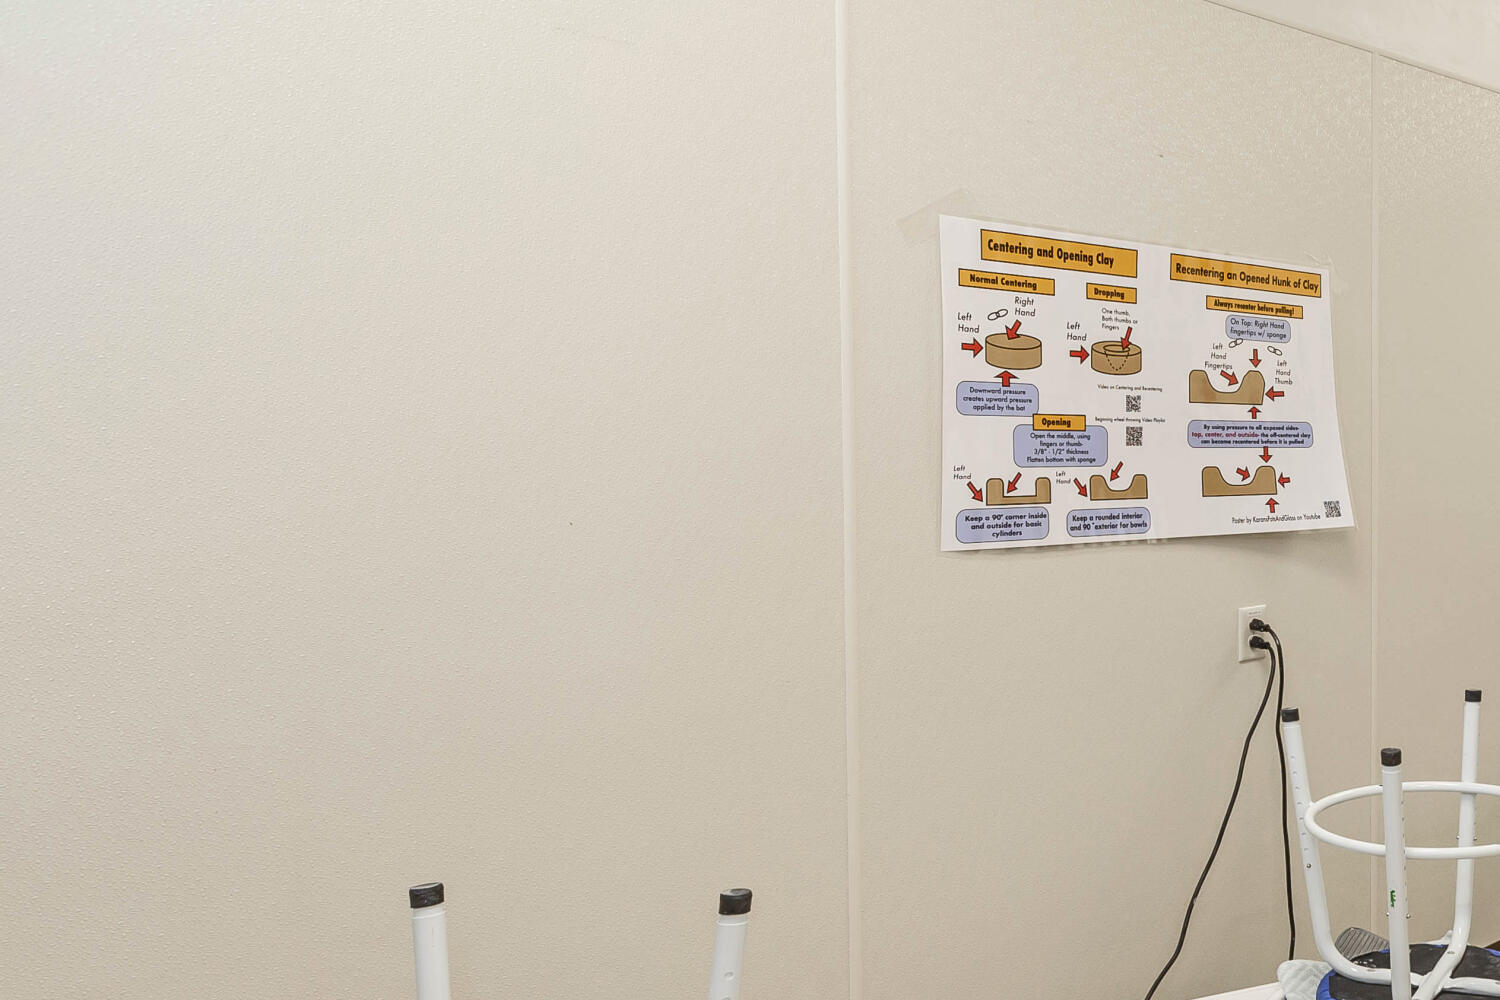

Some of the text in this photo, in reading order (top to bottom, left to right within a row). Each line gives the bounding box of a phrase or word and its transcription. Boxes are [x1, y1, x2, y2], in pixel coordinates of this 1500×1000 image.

[988, 239, 1114, 268] Centering and Opening Clay
[970, 274, 1037, 290] Normal Centering
[1176, 263, 1318, 292] Recentering an Opened Hunk of Clay
[1094, 288, 1124, 299] Dropping
[1015, 296, 1034, 307] Right
[1015, 308, 1035, 316] Hand
[1214, 300, 1233, 309] Always
[1257, 303, 1274, 312] before
[1275, 306, 1294, 316] pulling!
[958, 312, 971, 320] Left
[958, 324, 979, 333] Hand
[1067, 322, 1080, 330] Left
[1102, 323, 1119, 331] Fingers
[1241, 319, 1252, 327] Top:
[1255, 320, 1268, 329] Right
[1067, 333, 1086, 341] Hand
[1230, 327, 1256, 336] fingertips
[1267, 331, 1286, 339] sponge
[1205, 361, 1232, 370] Fingertips
[1042, 418, 1071, 427] Opening
[1246, 516, 1251, 524] by
